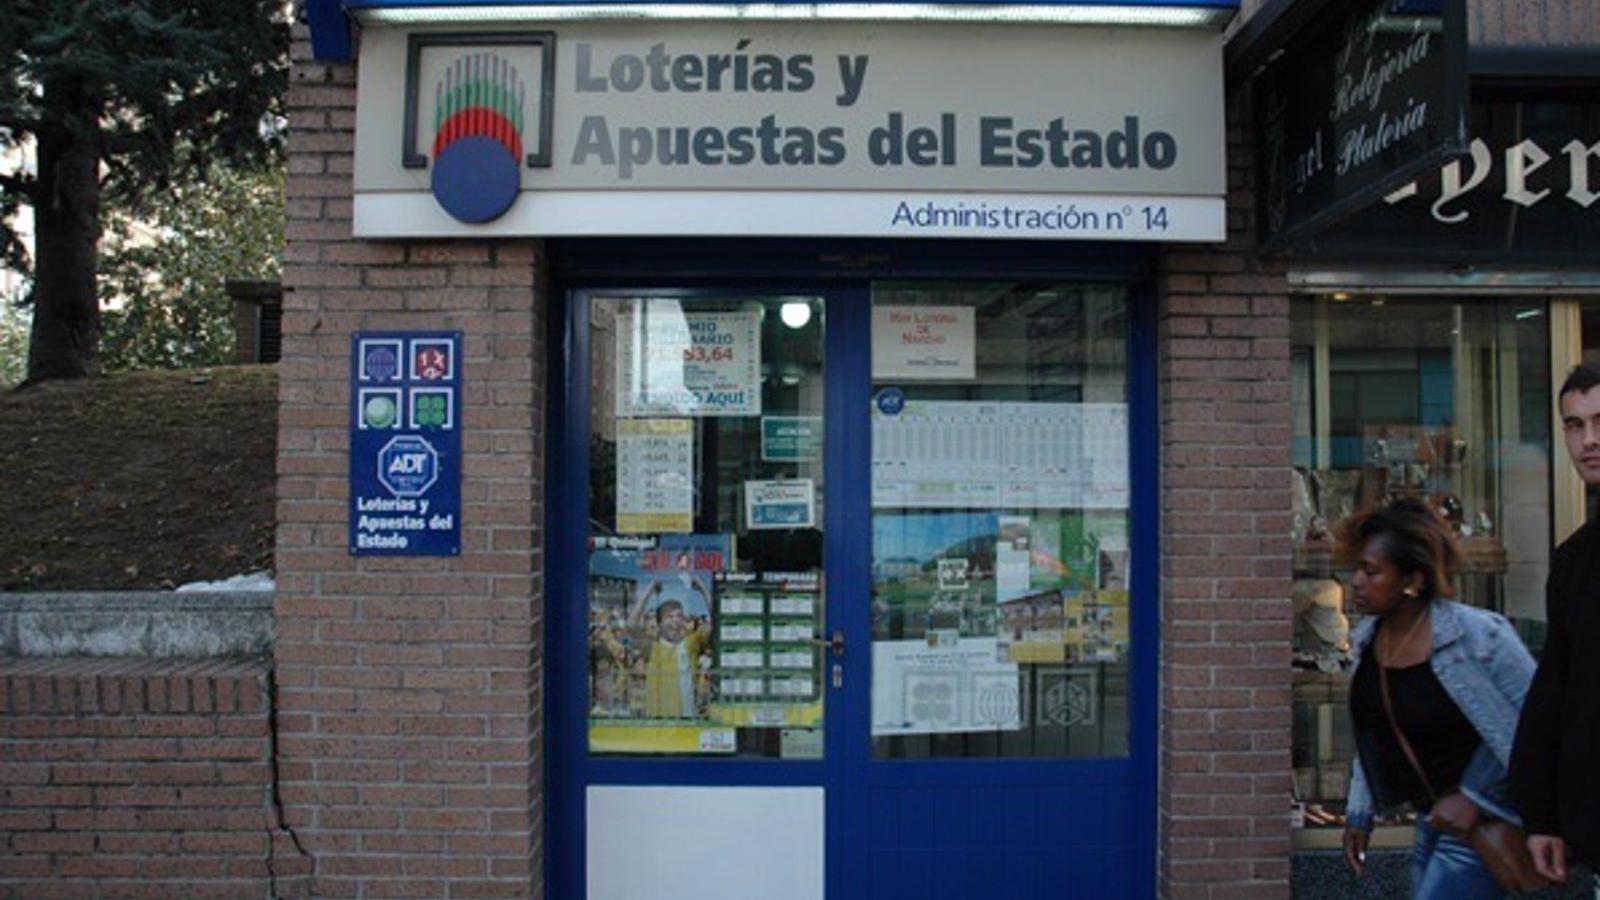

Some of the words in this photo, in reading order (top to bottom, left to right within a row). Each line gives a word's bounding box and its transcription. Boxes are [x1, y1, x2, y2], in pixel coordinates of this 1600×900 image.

[574, 38, 815, 94] Loterías
[836, 54, 869, 107] y
[570, 114, 847, 179] Apuestas
[867, 112, 956, 167] del
[979, 116, 1178, 170] Estado
[891, 200, 1100, 231] Administración
[1144, 206, 1170, 231] 14
[388, 453, 427, 474] ADT
[419, 499, 430, 515] y
[357, 515, 426, 532] Apuestas
[428, 514, 454, 530] del
[357, 533, 408, 549] Estado
